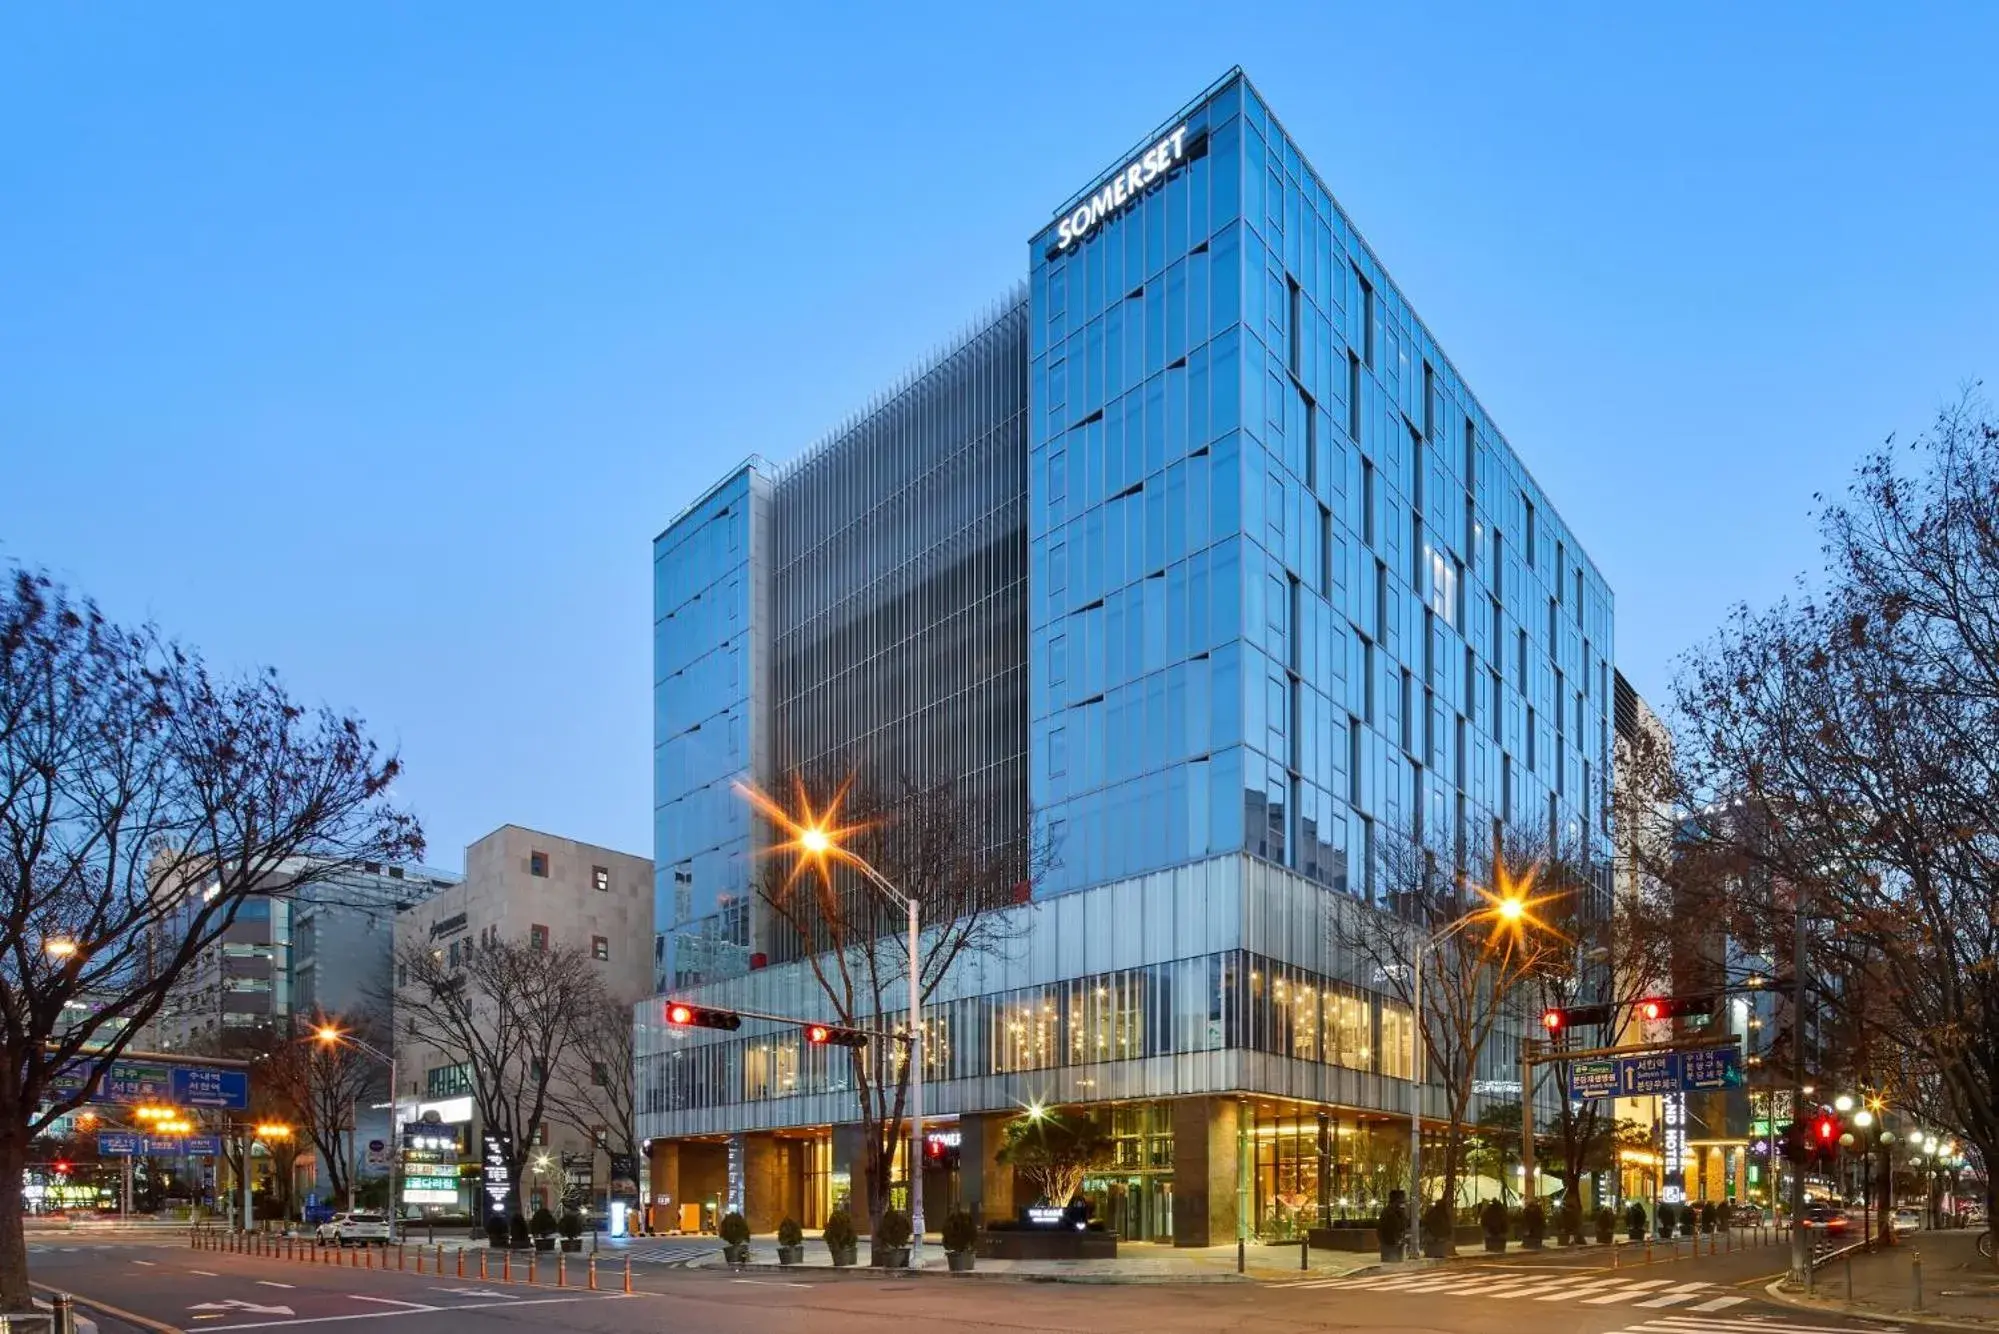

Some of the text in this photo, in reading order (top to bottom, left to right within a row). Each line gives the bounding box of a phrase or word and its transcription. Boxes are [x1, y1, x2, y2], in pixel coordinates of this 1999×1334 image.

[1057, 126, 1187, 250] SOMERSET
[1637, 1058, 1666, 1071] 서현역
[189, 1081, 221, 1092] 서현역
[1664, 1129, 1678, 1175] HOTEL
